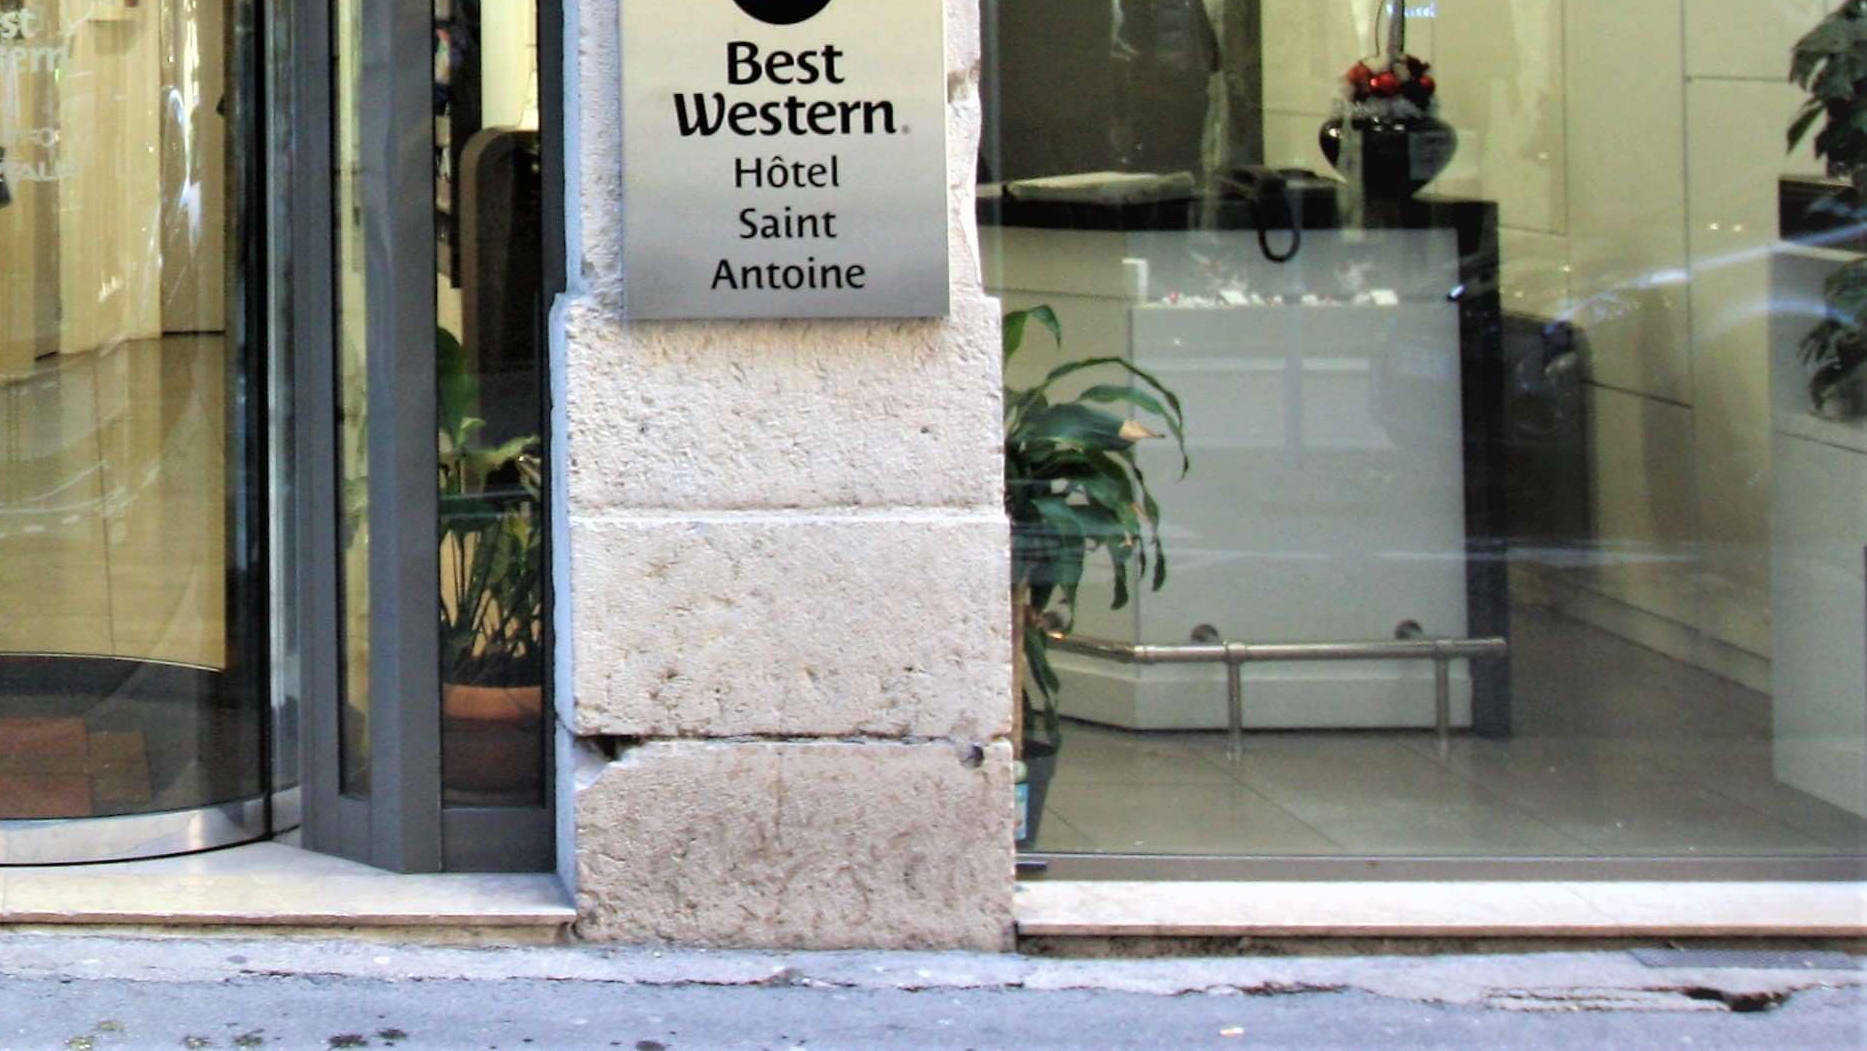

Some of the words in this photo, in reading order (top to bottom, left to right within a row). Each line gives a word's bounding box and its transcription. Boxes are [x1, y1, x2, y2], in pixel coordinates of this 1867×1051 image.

[727, 41, 845, 85] Best
[673, 92, 898, 137] Western
[735, 155, 840, 188] Hôtel
[739, 207, 837, 238] Saint
[711, 258, 866, 289] Antoine
